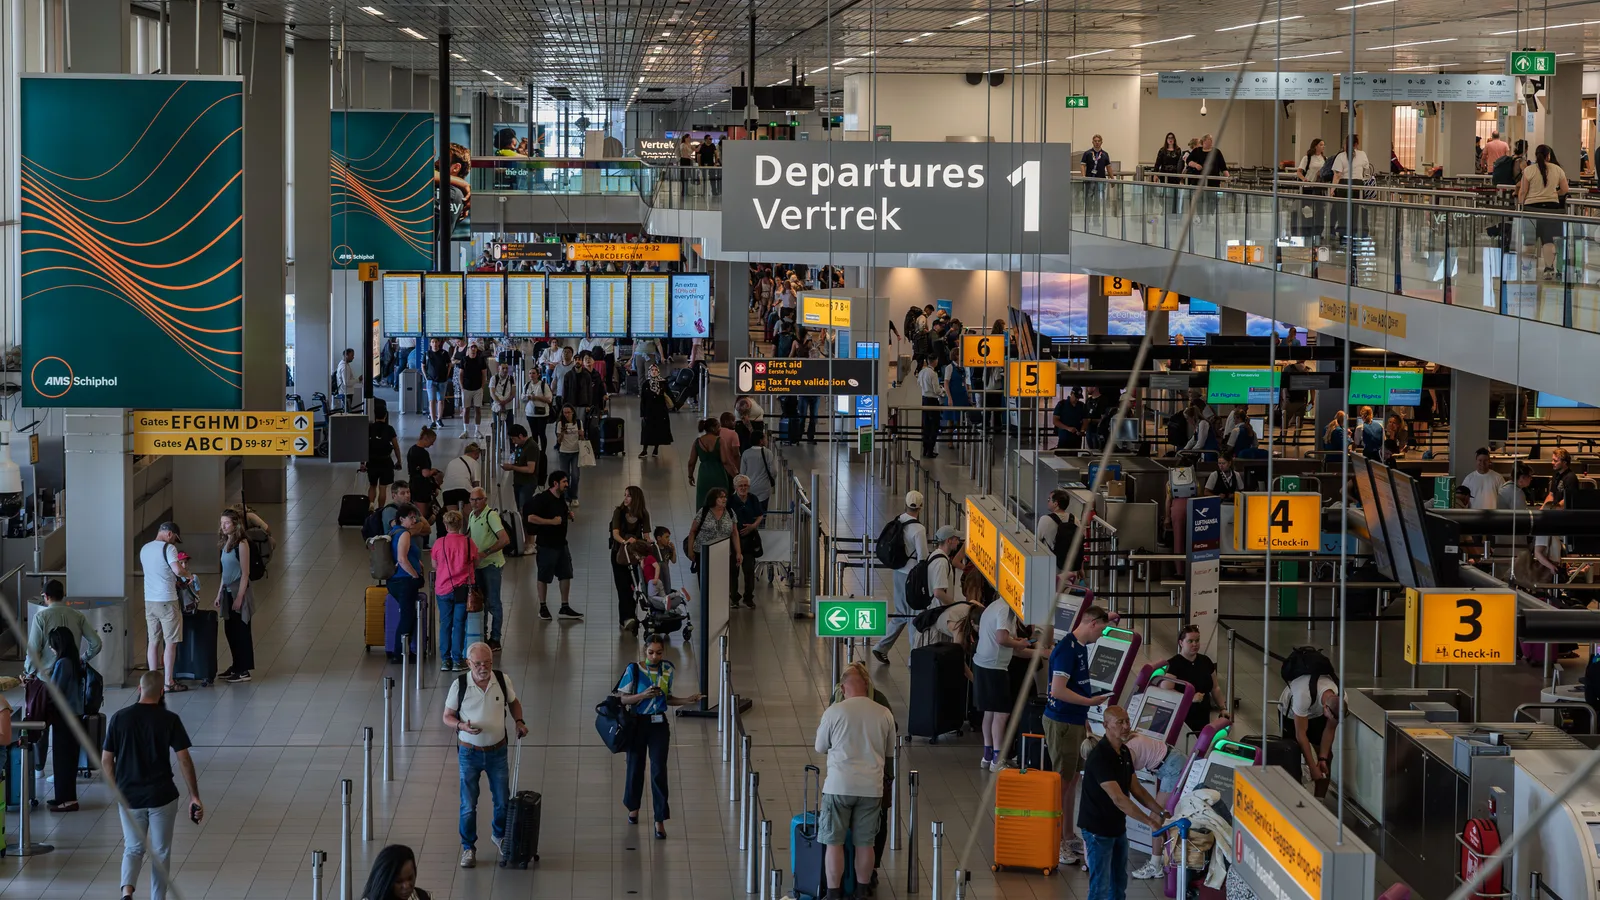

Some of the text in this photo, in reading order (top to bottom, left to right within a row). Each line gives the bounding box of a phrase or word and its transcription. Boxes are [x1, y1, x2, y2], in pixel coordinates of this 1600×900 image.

[640, 140, 674, 149] Vertrek
[754, 155, 985, 195] Departures
[1006, 160, 1040, 232] 1
[752, 197, 902, 231] Vertrek
[1113, 276, 1122, 289] 8
[977, 338, 990, 357] 6
[44, 376, 117, 388] AMS Schiphol
[1025, 364, 1038, 386] 5
[140, 418, 168, 426] Gates
[154, 440, 182, 448] Gates
[231, 438, 242, 450] D
[245, 440, 272, 448] 59-87
[1270, 500, 1293, 533] 4
[1272, 538, 1308, 546] Check-in
[1454, 598, 1483, 642] 3
[1453, 649, 1500, 658] Check-in
[1244, 794, 1272, 837] Self-service
[1273, 822, 1296, 864] baggage
[1296, 848, 1321, 888] drop-off
